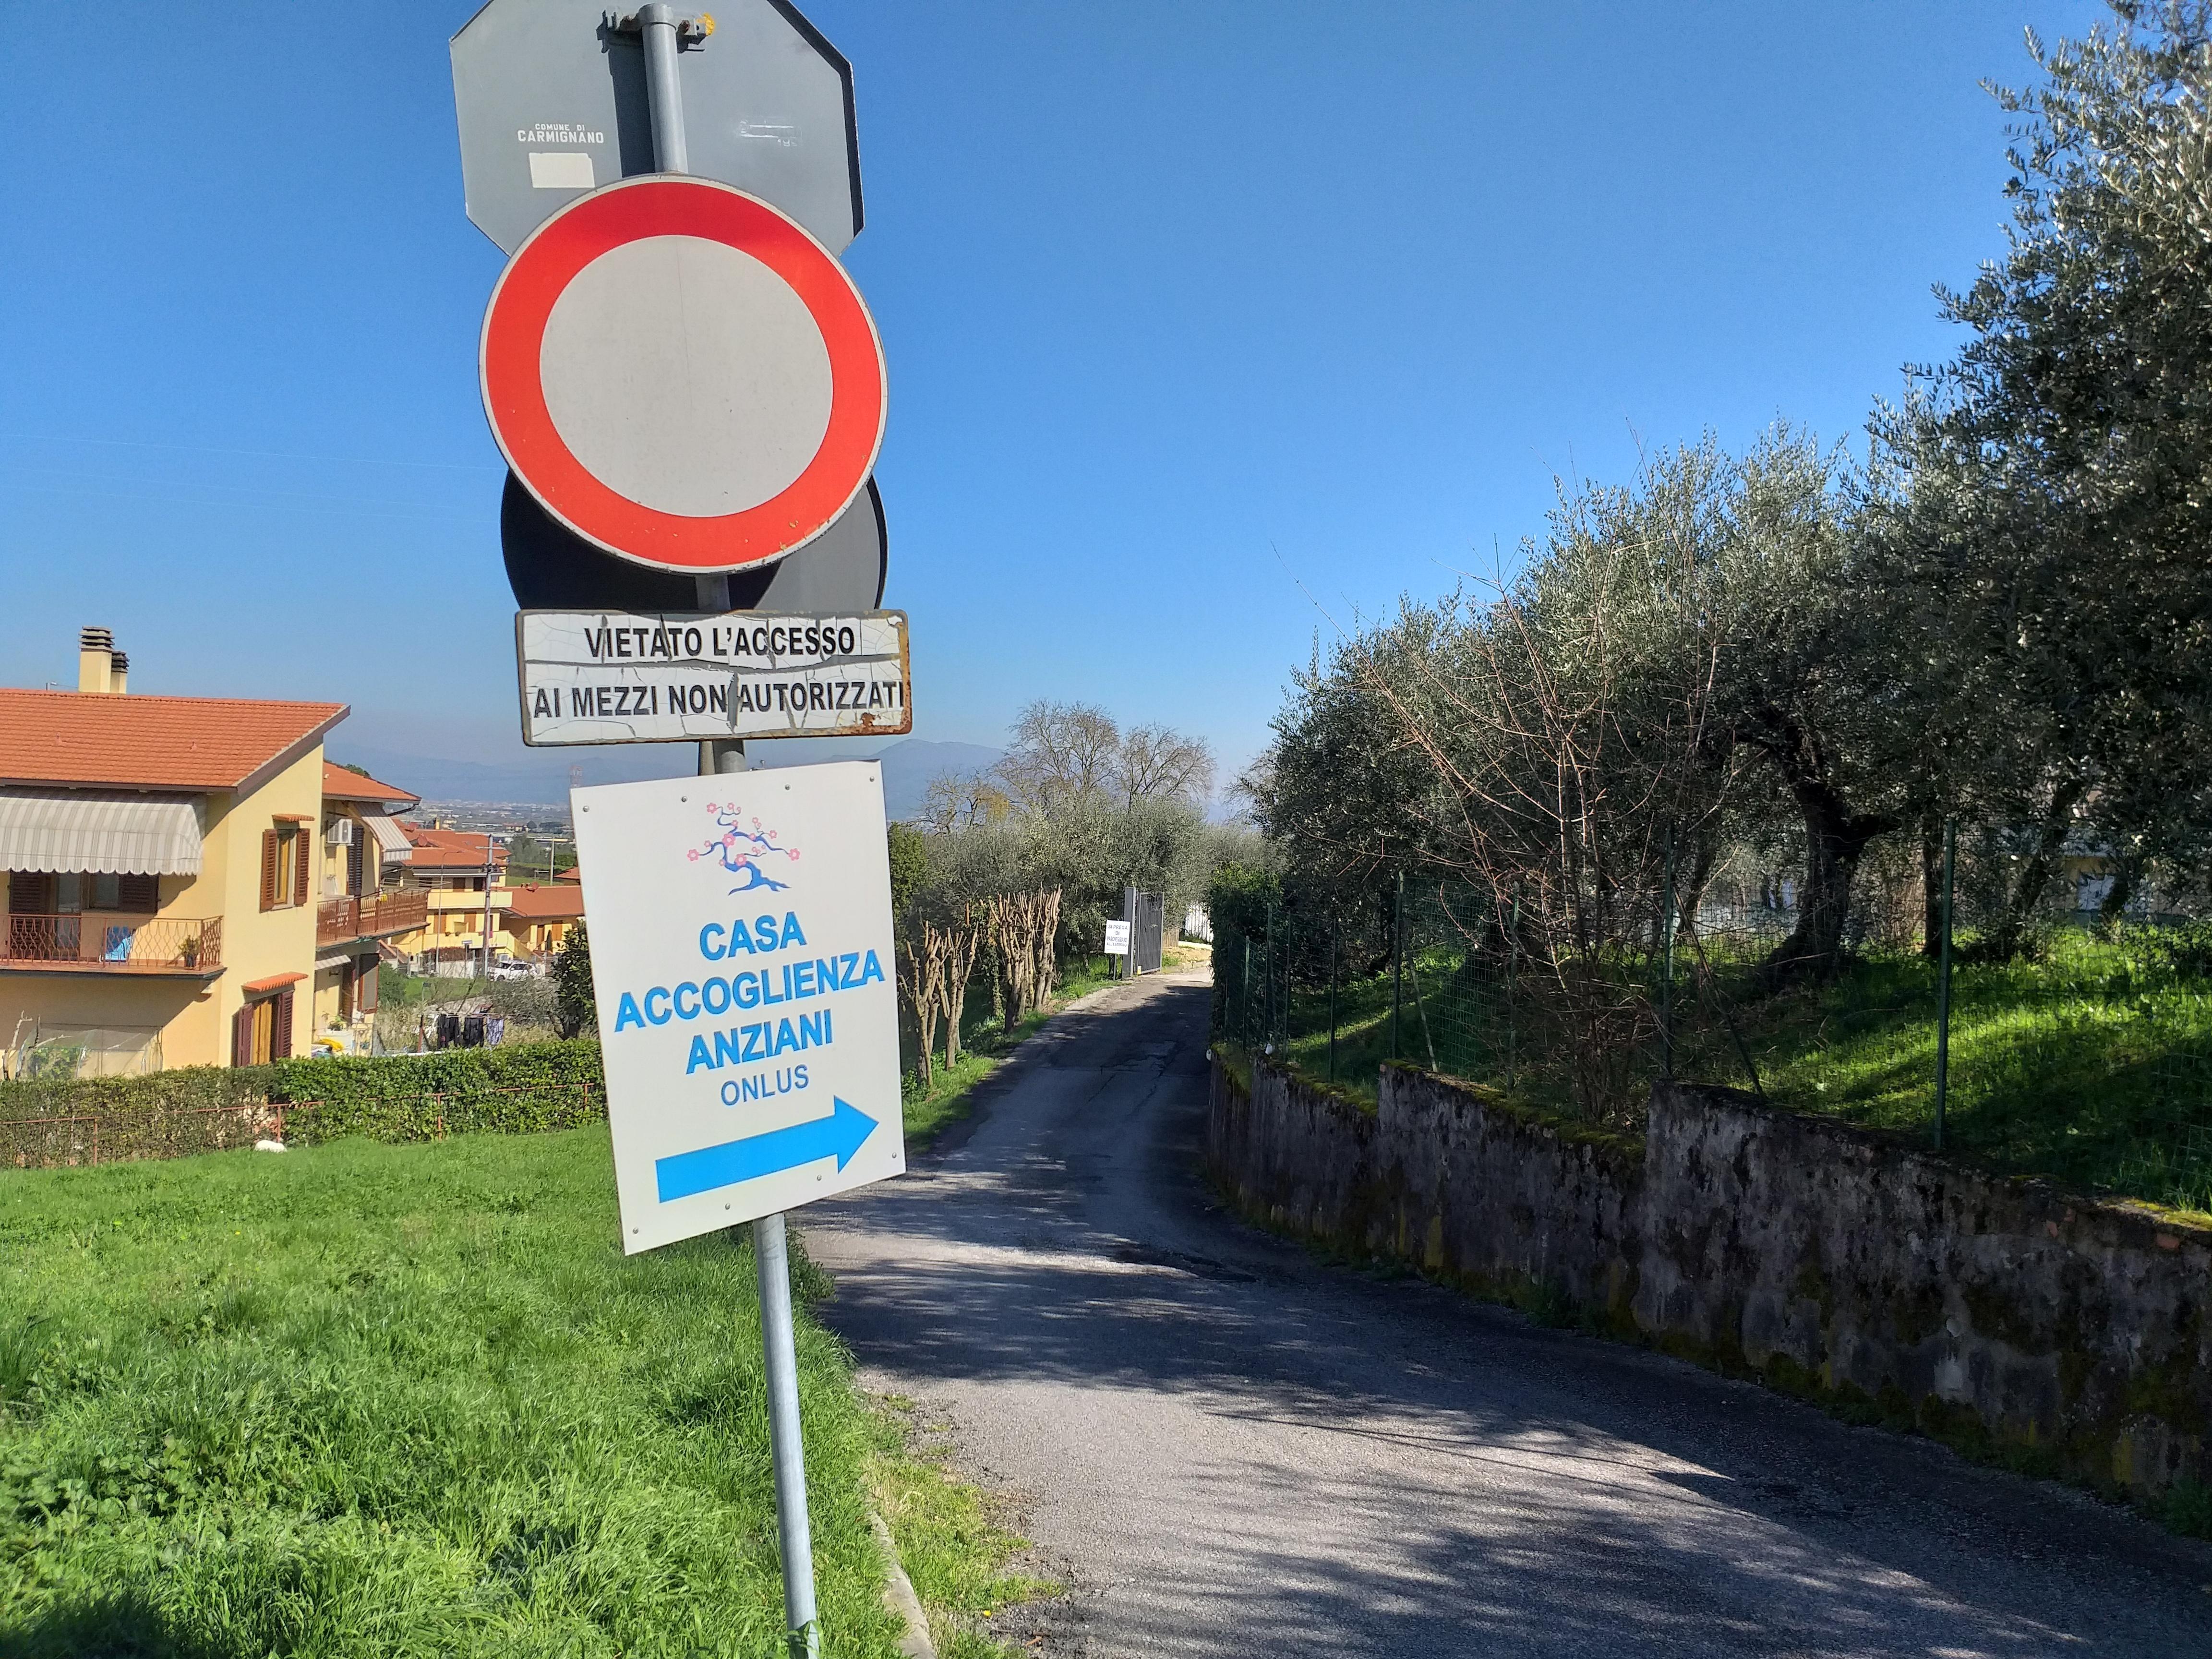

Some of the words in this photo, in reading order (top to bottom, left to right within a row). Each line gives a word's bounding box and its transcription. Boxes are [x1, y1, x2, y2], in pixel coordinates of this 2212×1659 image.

[517, 130, 604, 143] CARMIGNANO
[584, 627, 702, 657] VIETATO
[713, 626, 854, 656] L'ACCESSO
[534, 687, 561, 718] AI
[572, 686, 658, 717] MEZZI
[669, 684, 727, 715] NON
[740, 681, 904, 712] AUTORIZZATI
[699, 912, 807, 961] CASA
[615, 950, 885, 1032] ACCOGLIENZA
[686, 1010, 833, 1074] ANZIANI
[721, 1064, 809, 1106] ONLUS
